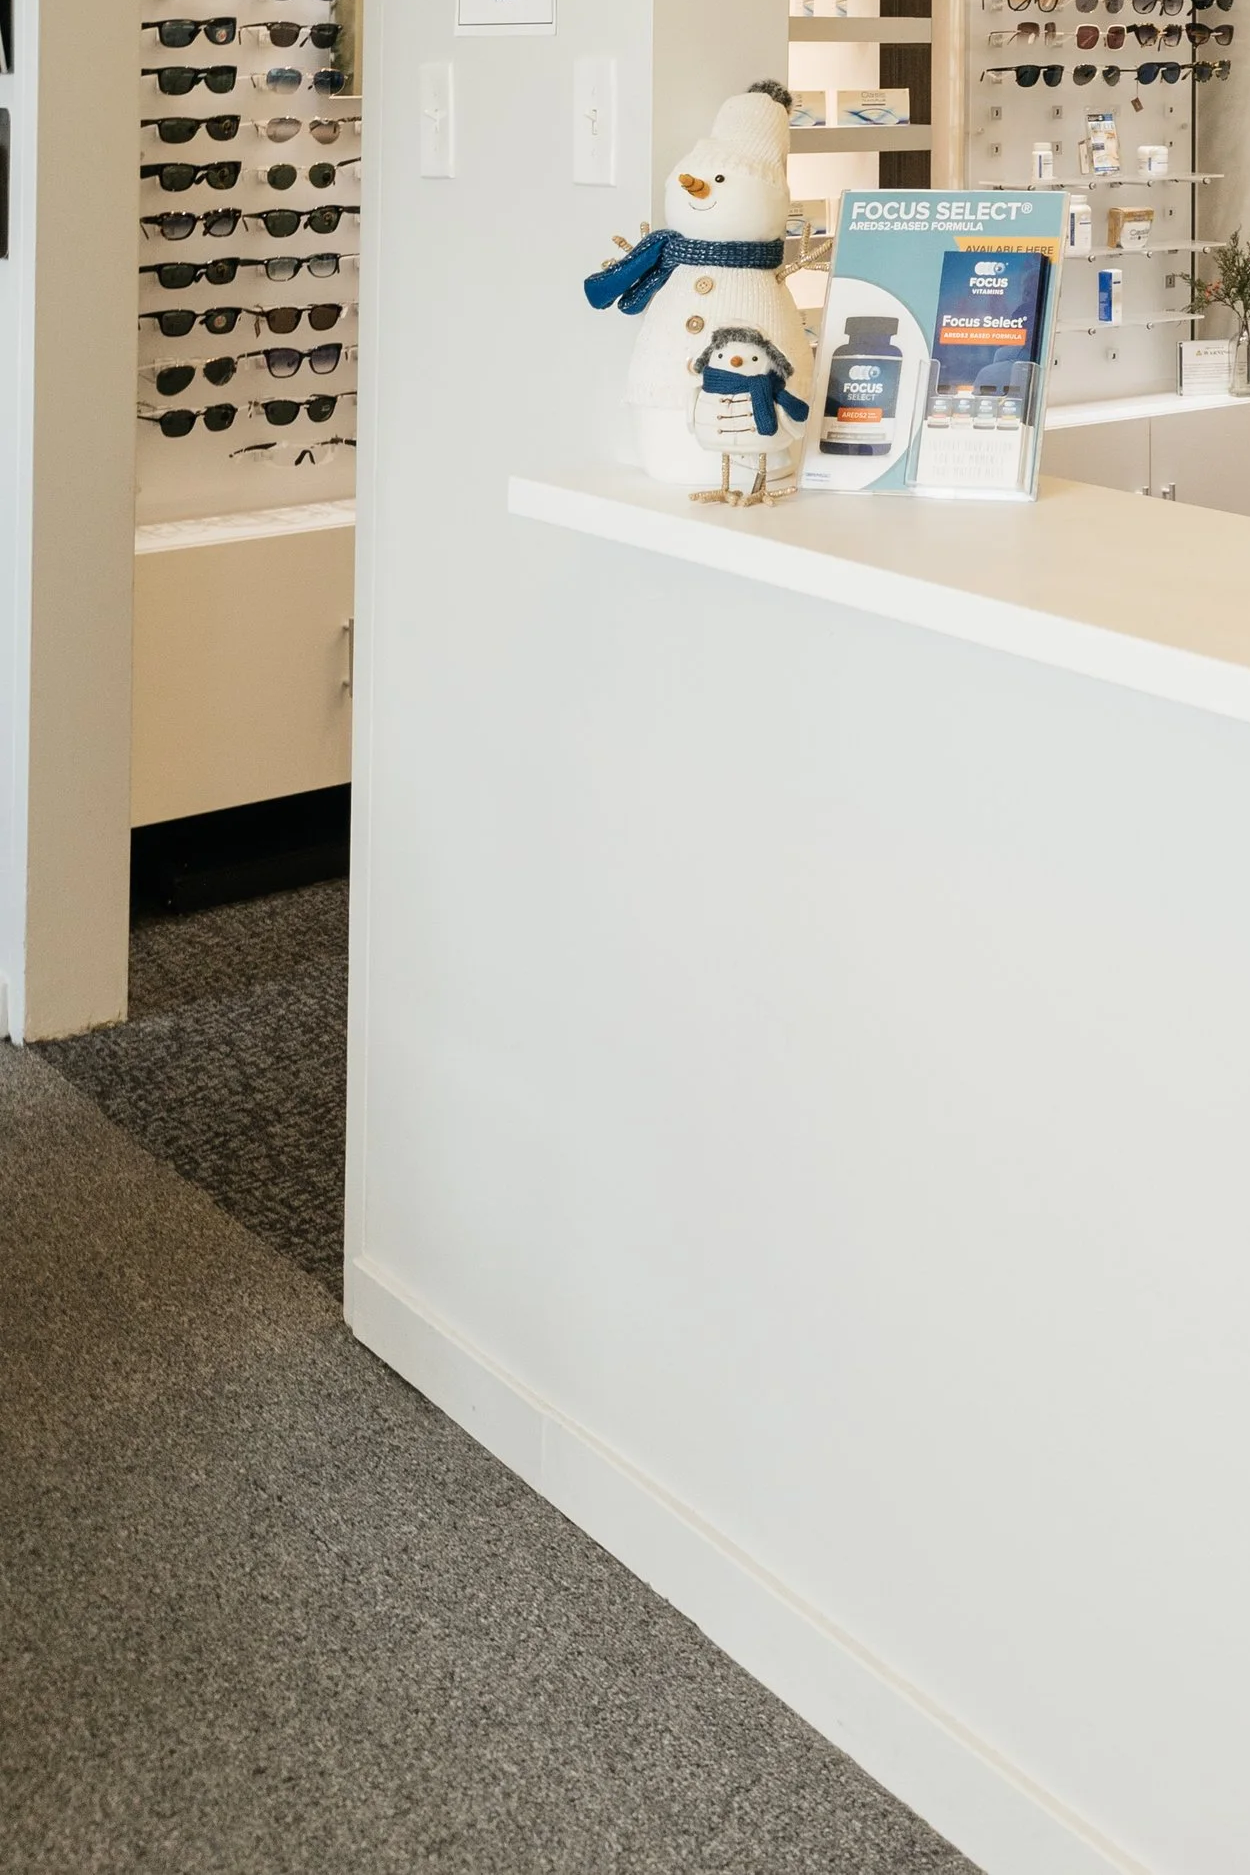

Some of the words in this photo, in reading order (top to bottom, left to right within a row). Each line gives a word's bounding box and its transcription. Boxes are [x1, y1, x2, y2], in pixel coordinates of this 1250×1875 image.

[851, 201, 930, 221] FOCUS
[849, 221, 930, 231] AREDS2-BASED
[931, 222, 984, 232] FORMULA
[1025, 245, 1054, 255] HERE
[969, 277, 1009, 288] FOCUS
[942, 314, 981, 328] Focus
[843, 382, 884, 394] FOCUS
[847, 393, 876, 401] SELECT
[842, 411, 867, 419] AREDS2
